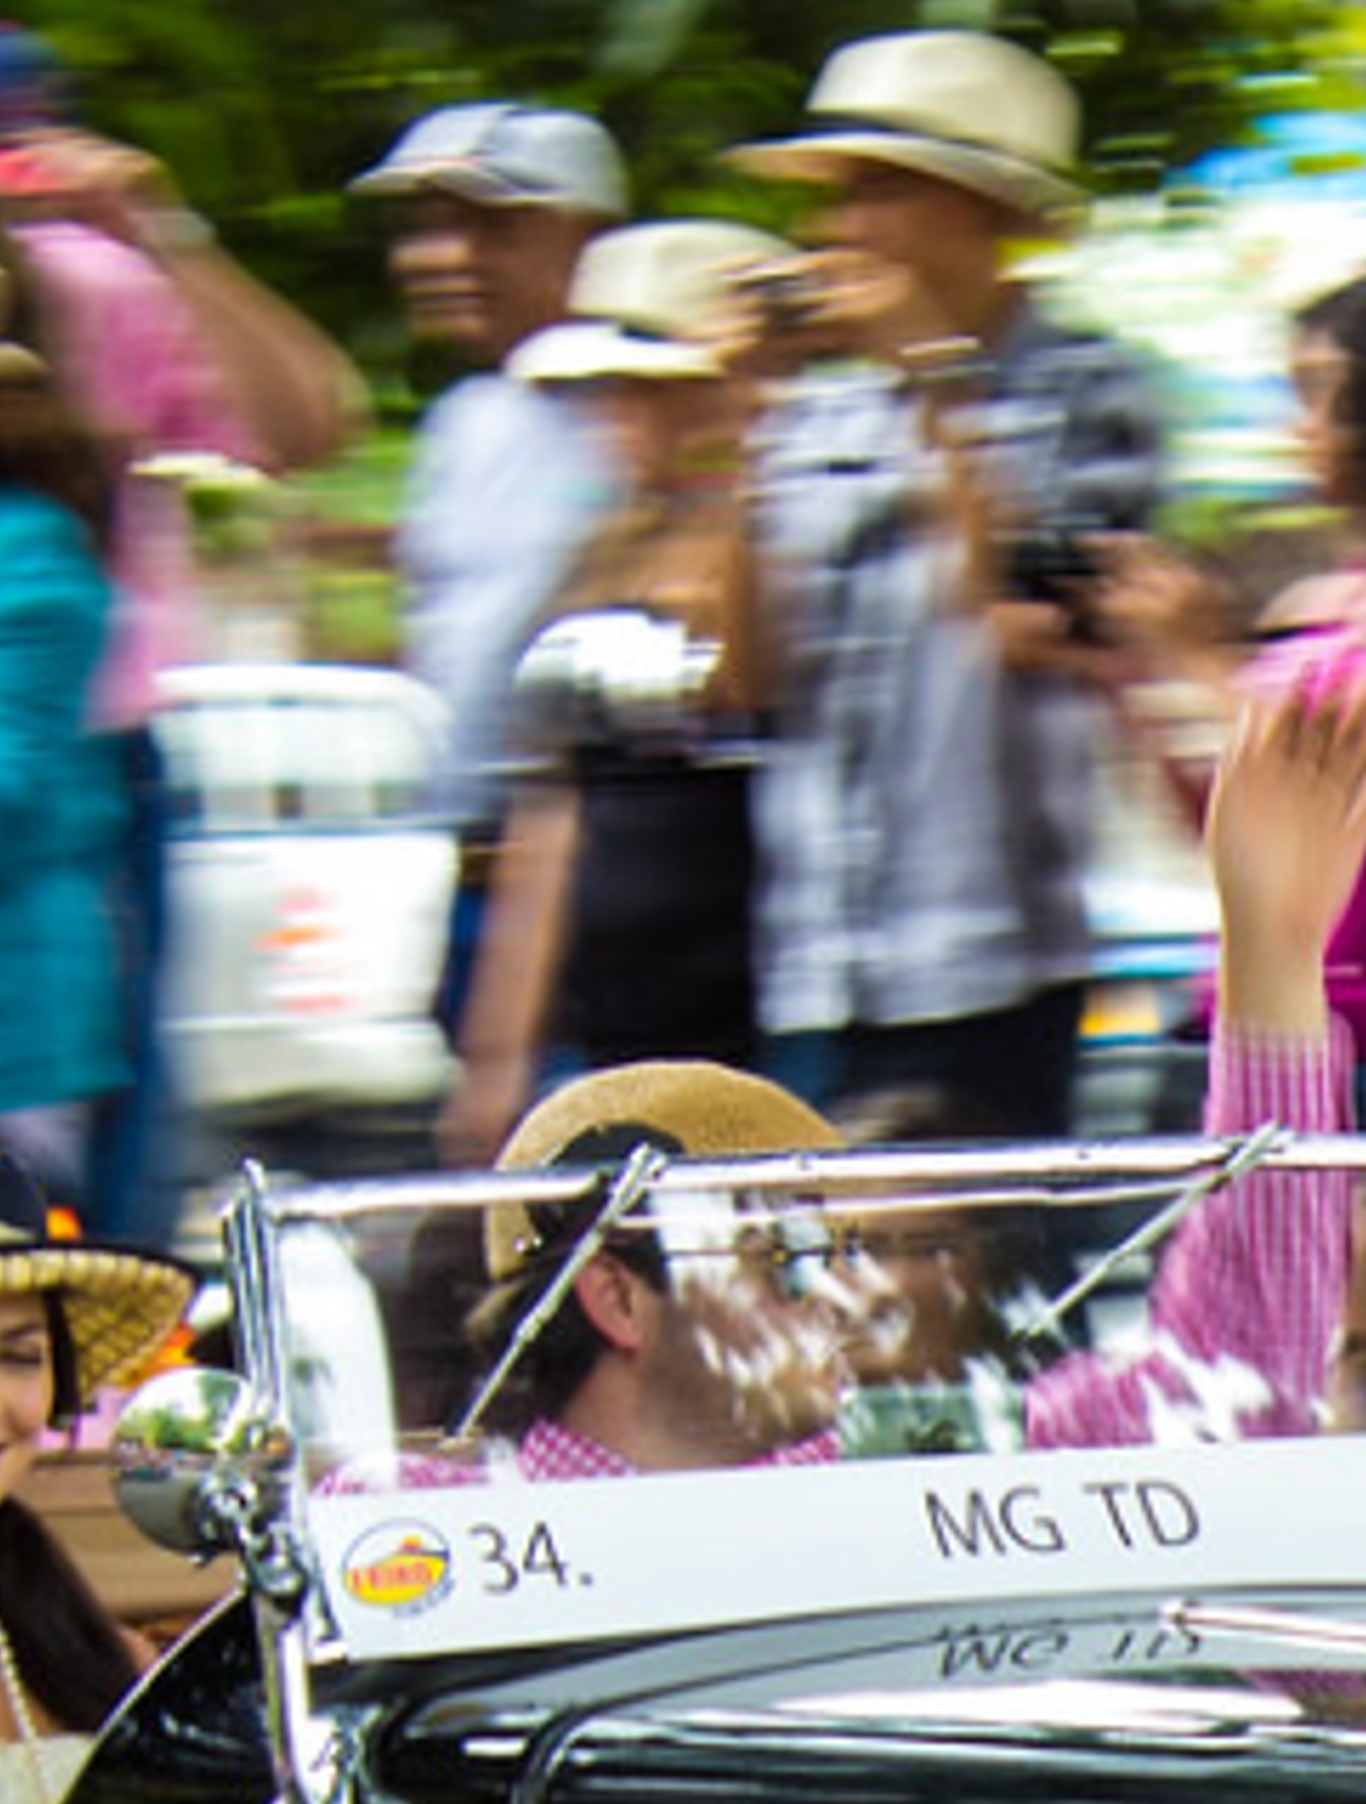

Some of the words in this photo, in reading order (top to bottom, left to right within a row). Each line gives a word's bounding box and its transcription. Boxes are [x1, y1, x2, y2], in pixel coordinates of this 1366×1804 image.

[924, 1485, 1066, 1558] MG
[1082, 1480, 1200, 1548] TD
[468, 1521, 593, 1595] 34.
